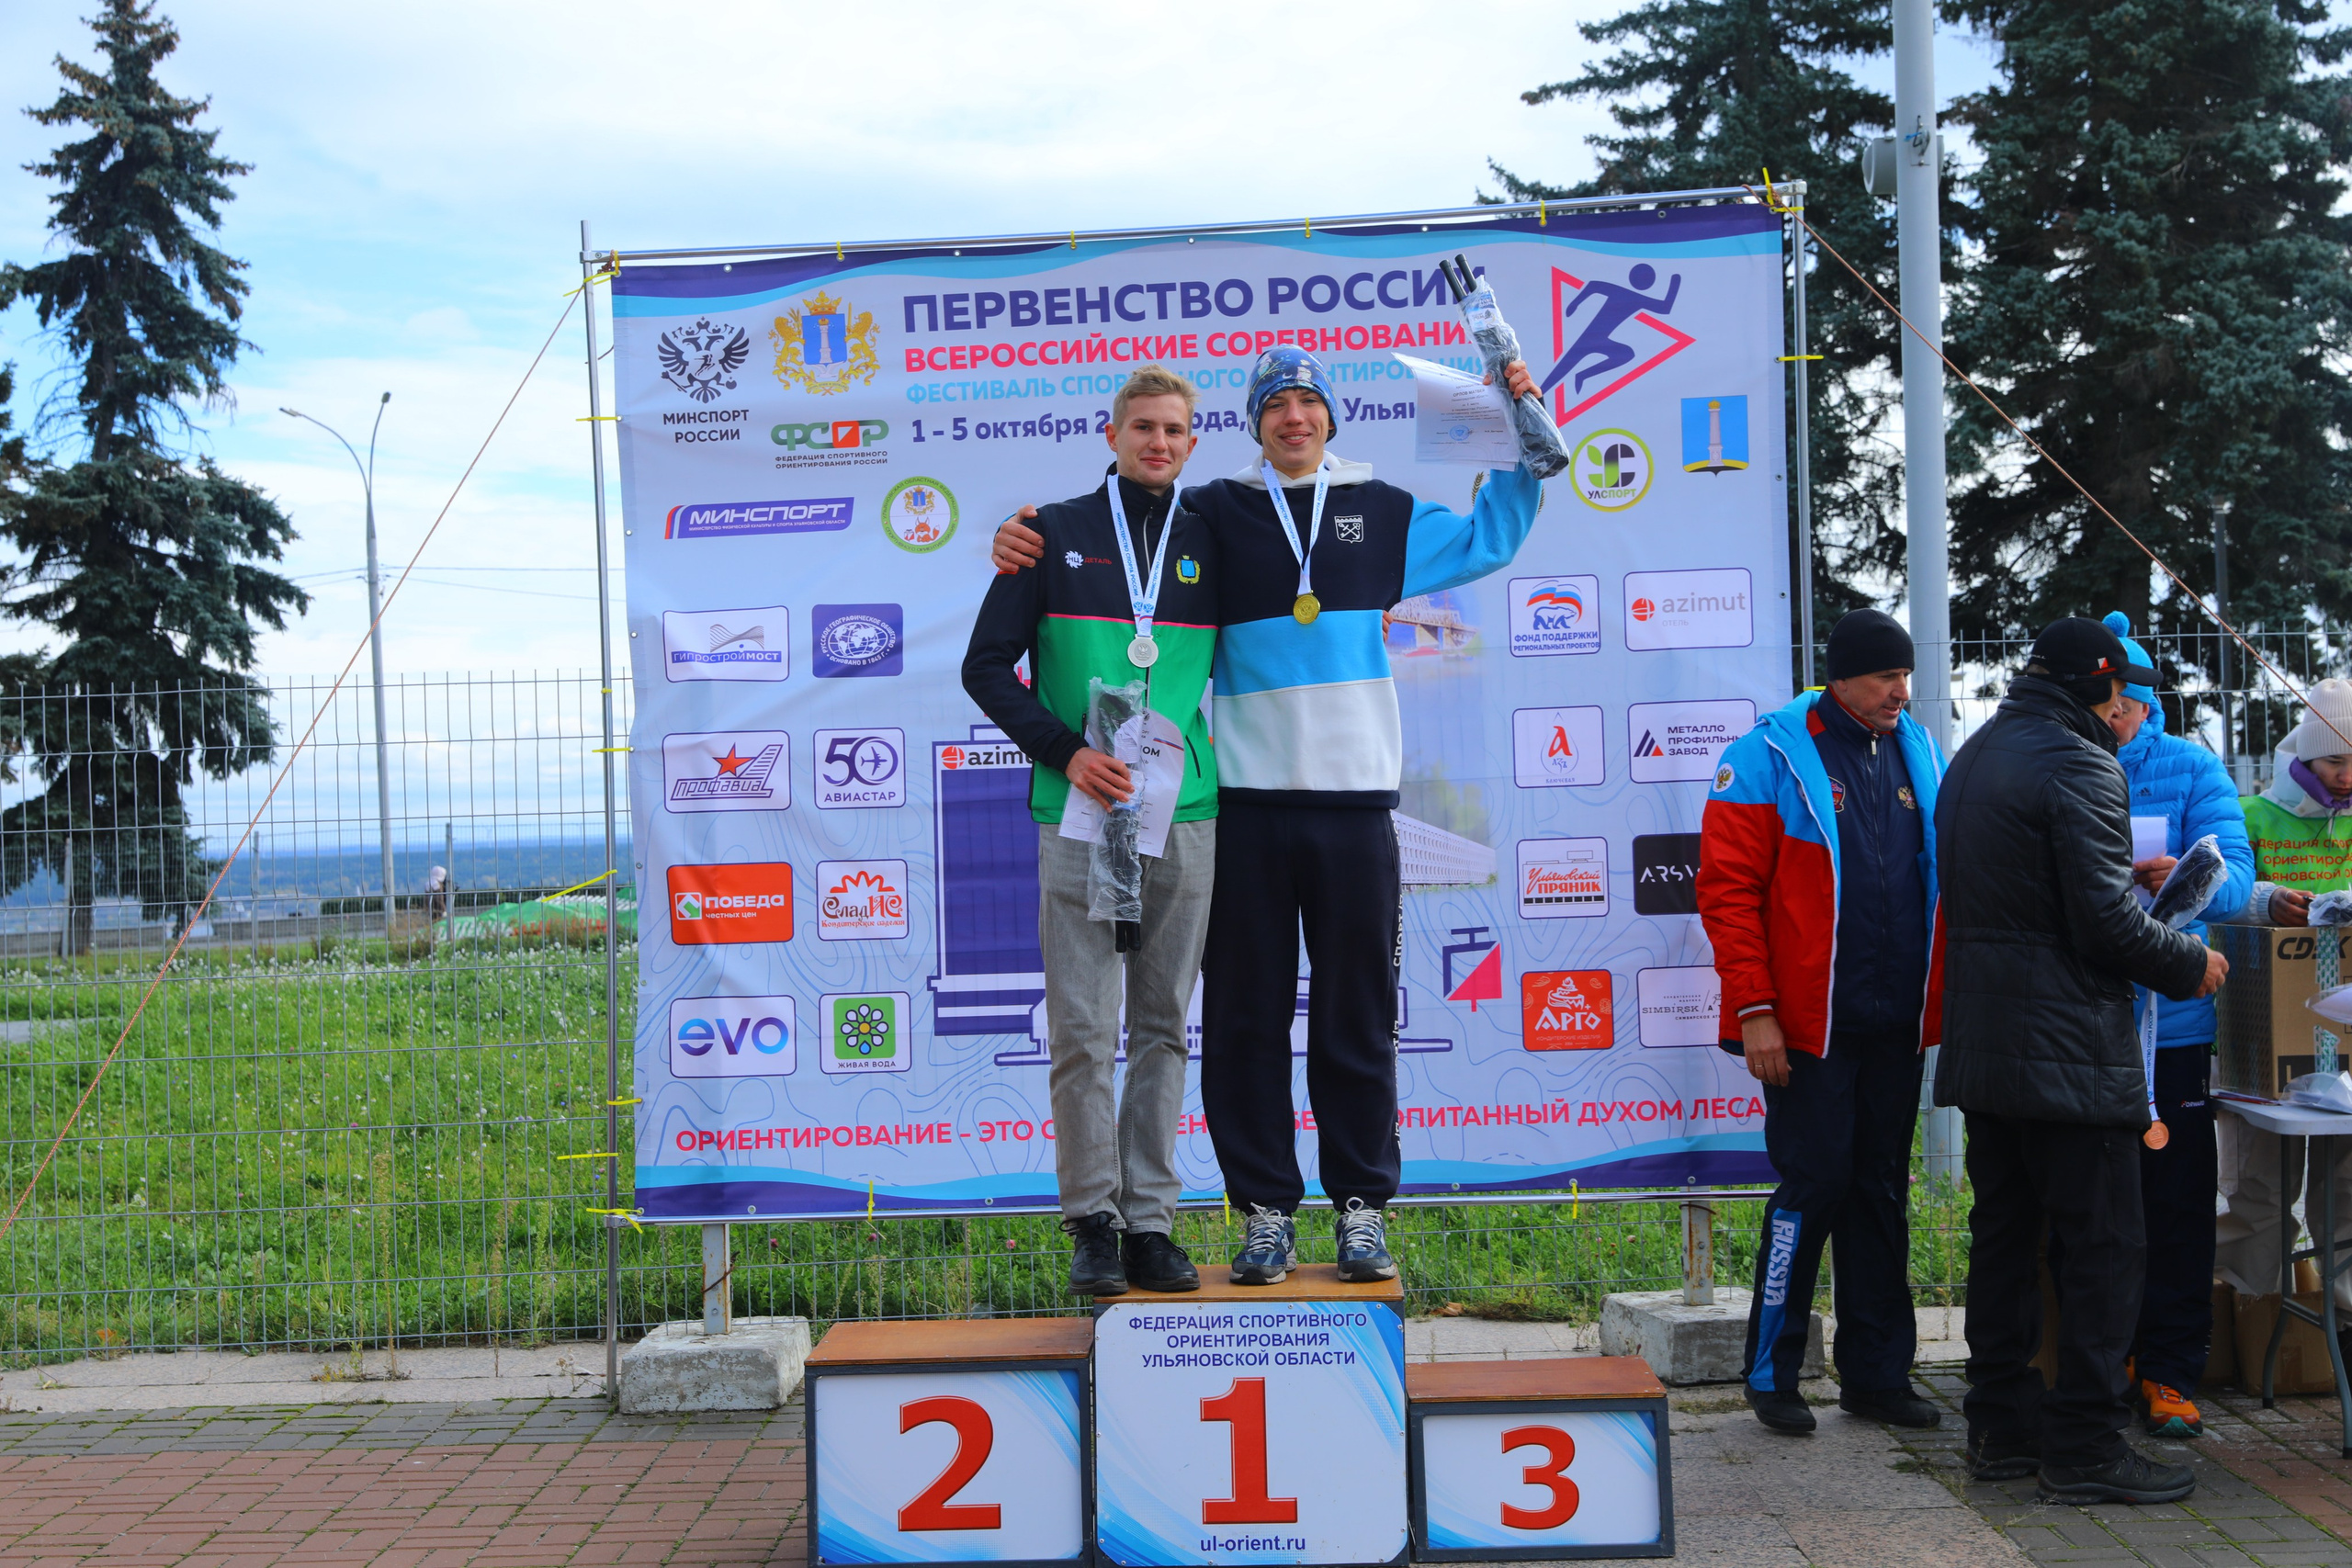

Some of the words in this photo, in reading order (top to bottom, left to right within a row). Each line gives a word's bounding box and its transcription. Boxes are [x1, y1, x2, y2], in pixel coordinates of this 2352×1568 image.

[904, 278, 1253, 333] ПЕРВЕНСТВО
[905, 333, 1198, 372] ВСЕРОССИЙСКИЕ
[1206, 321, 1473, 356] СОРЕВНОВАНИ
[906, 378, 1056, 404] ФЕСТИВАЛЬ
[1061, 367, 1247, 395] СПОРНОГО
[663, 410, 749, 425] МИНСПОРТ
[674, 429, 741, 443] РОССИИ
[911, 420, 926, 443] 1
[952, 417, 968, 441] 5
[975, 412, 1088, 443] октября
[775, 454, 825, 462] ФЕДЕРАЦИЯ
[827, 450, 888, 459] СПОРТИВНОГО
[775, 460, 852, 469] ОРИЕНТИРОВАНИЯ
[882, 482, 905, 518] УЛЬЯНОВСКАЯ
[905, 478, 939, 486] ОБЛАСТНАЯ
[939, 483, 958, 516] ФЕДЕРАЦИЯ
[1588, 489, 1636, 500] УЛСПОРТ
[689, 503, 846, 525] МИНСПОРТ
[1084, 557, 1113, 565] ДЕТАЛЬ
[1116, 513, 1129, 552] МИНИСТЕРСТВО
[1125, 552, 1135, 572] СПОРТА
[1130, 573, 1139, 596] РОССИИ
[1662, 592, 1746, 614] azimut
[820, 626, 831, 653] РУССКОЕ
[829, 615, 882, 629] ГЕОГРАФИЧЕСКОЕ
[880, 622, 896, 649] ОБЩЕСТВО
[1514, 634, 1541, 642] ФОНД
[1543, 631, 1598, 641] ПОДДЕРЖКИ
[829, 656, 861, 665] ОСНОВАНО
[868, 654, 882, 664] 1845
[1668, 724, 1725, 734] МЕТАЛЛО
[1668, 748, 1708, 756] ЗАВОД
[824, 792, 896, 802] АВИАСТАР
[1527, 867, 1600, 895] Ульяновский
[1538, 881, 1601, 894] ПРЯНИК
[741, 910, 757, 919] цен
[821, 919, 876, 929] Кондитерские
[2278, 935, 2352, 960] CDK
[1642, 1005, 1699, 1014] SIMBIRSK
[678, 1017, 788, 1056] evo
[838, 1061, 869, 1069] ЖИВАЯ
[872, 1060, 897, 1068] ВОДА
[676, 1122, 952, 1152] ОРИЕНТИРОВАНИЕ
[978, 1120, 1034, 1142] ЭТО
[1577, 1099, 1682, 1126] ДУХОМ
[1690, 1096, 1766, 1120] ЛЕСА
[1764, 1219, 1796, 1306] RUSSIA
[1128, 1315, 1234, 1330] ФЕДЕРАЦИЯ
[1239, 1313, 1367, 1328] СПОРТИВНОГО
[1167, 1333, 1329, 1348] ОРИЕНТИРОВАНИЯ
[1142, 1349, 1269, 1368] УЛЬЯНОВСКОЙ
[1274, 1351, 1355, 1366] ОБЛАСТИ
[1200, 1376, 1297, 1525] 1
[898, 1395, 1001, 1531] 2
[1500, 1425, 1579, 1529] 3
[1200, 1535, 1306, 1551] ul-orient.ru
